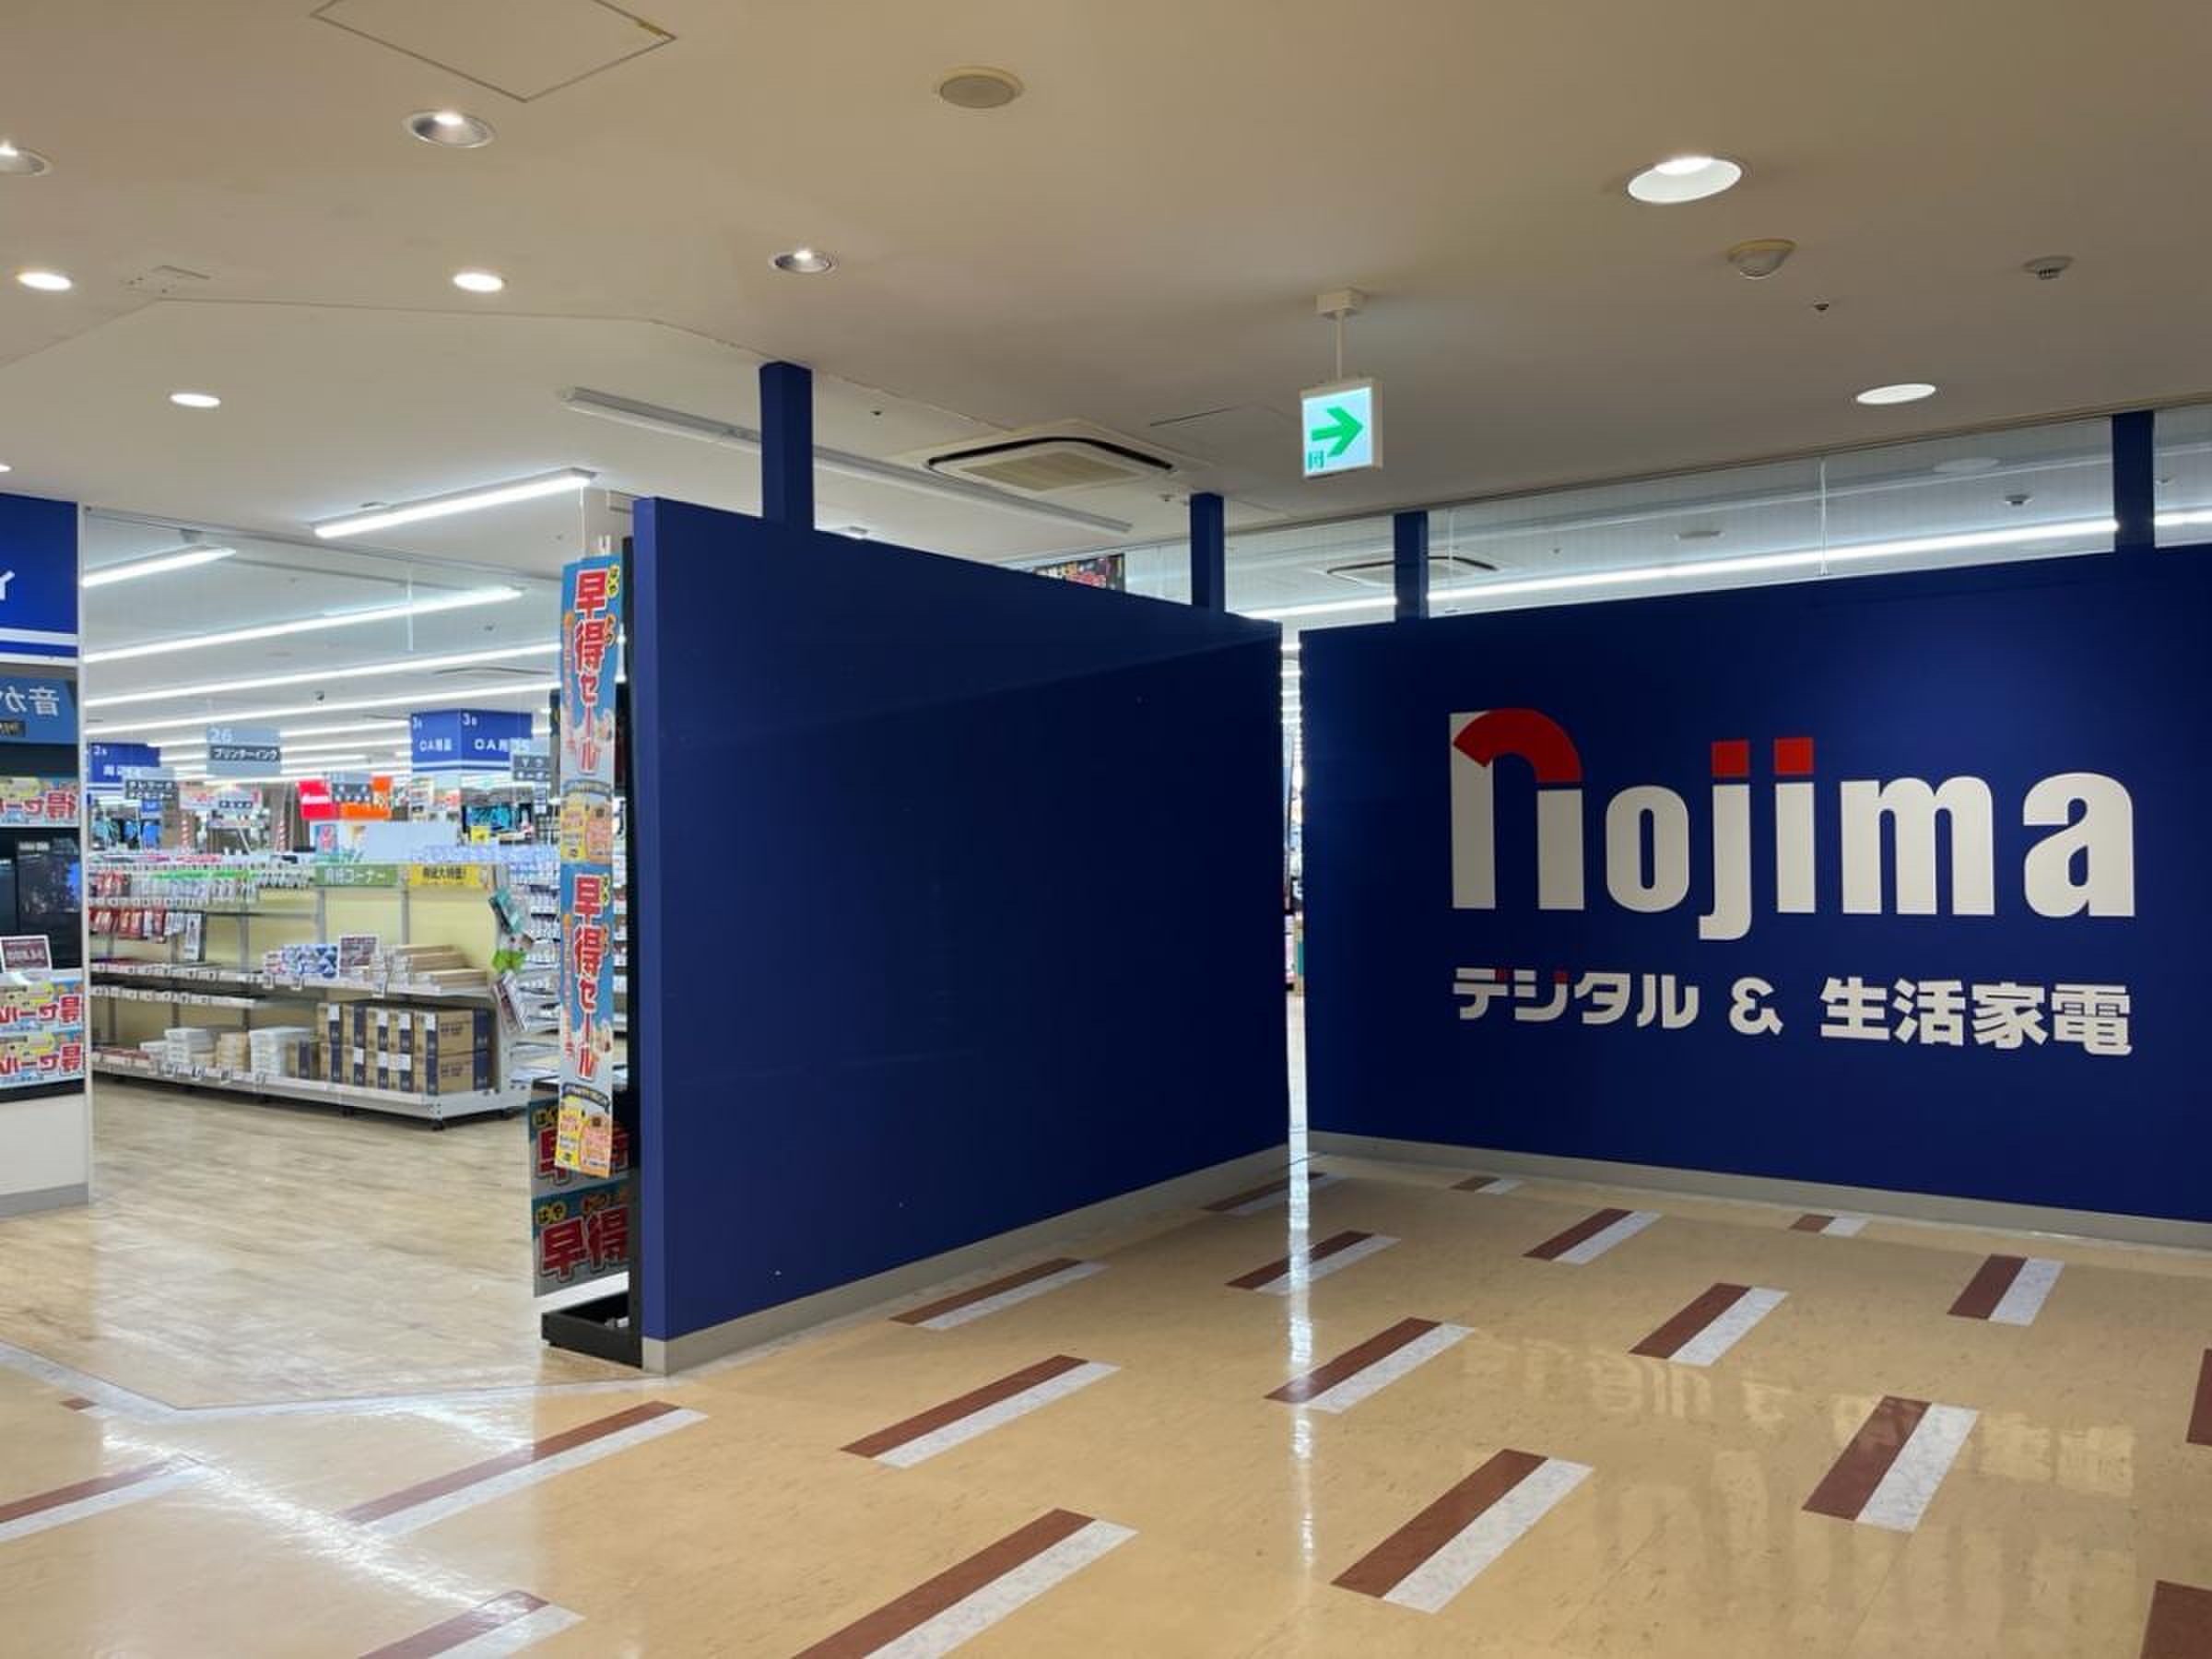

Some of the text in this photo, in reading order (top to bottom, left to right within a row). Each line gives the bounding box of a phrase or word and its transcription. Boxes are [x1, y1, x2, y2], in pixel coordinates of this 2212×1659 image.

[213, 747, 278, 760] プリンターインク
[574, 567, 608, 775] 早得セール
[1450, 707, 2136, 940] nojima
[574, 874, 604, 1082] 早得セール
[1452, 966, 2133, 1056] デジタル & 生活家電
